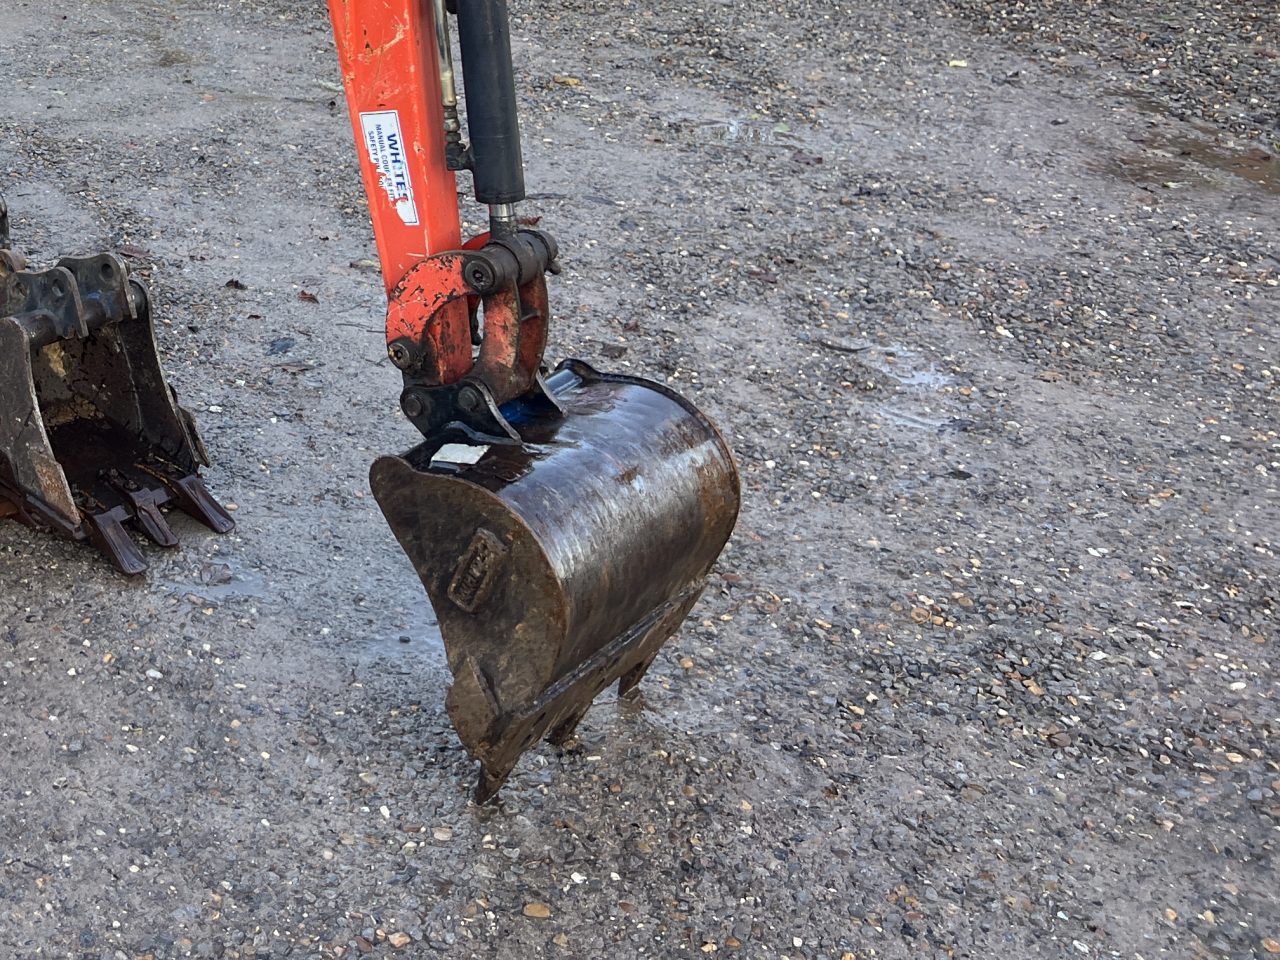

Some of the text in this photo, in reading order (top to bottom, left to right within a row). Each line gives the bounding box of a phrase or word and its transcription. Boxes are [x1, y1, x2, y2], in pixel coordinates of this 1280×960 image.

[367, 131, 378, 157] SAFETY
[375, 124, 384, 152] MANUAL
[387, 133, 408, 201] WHTE
